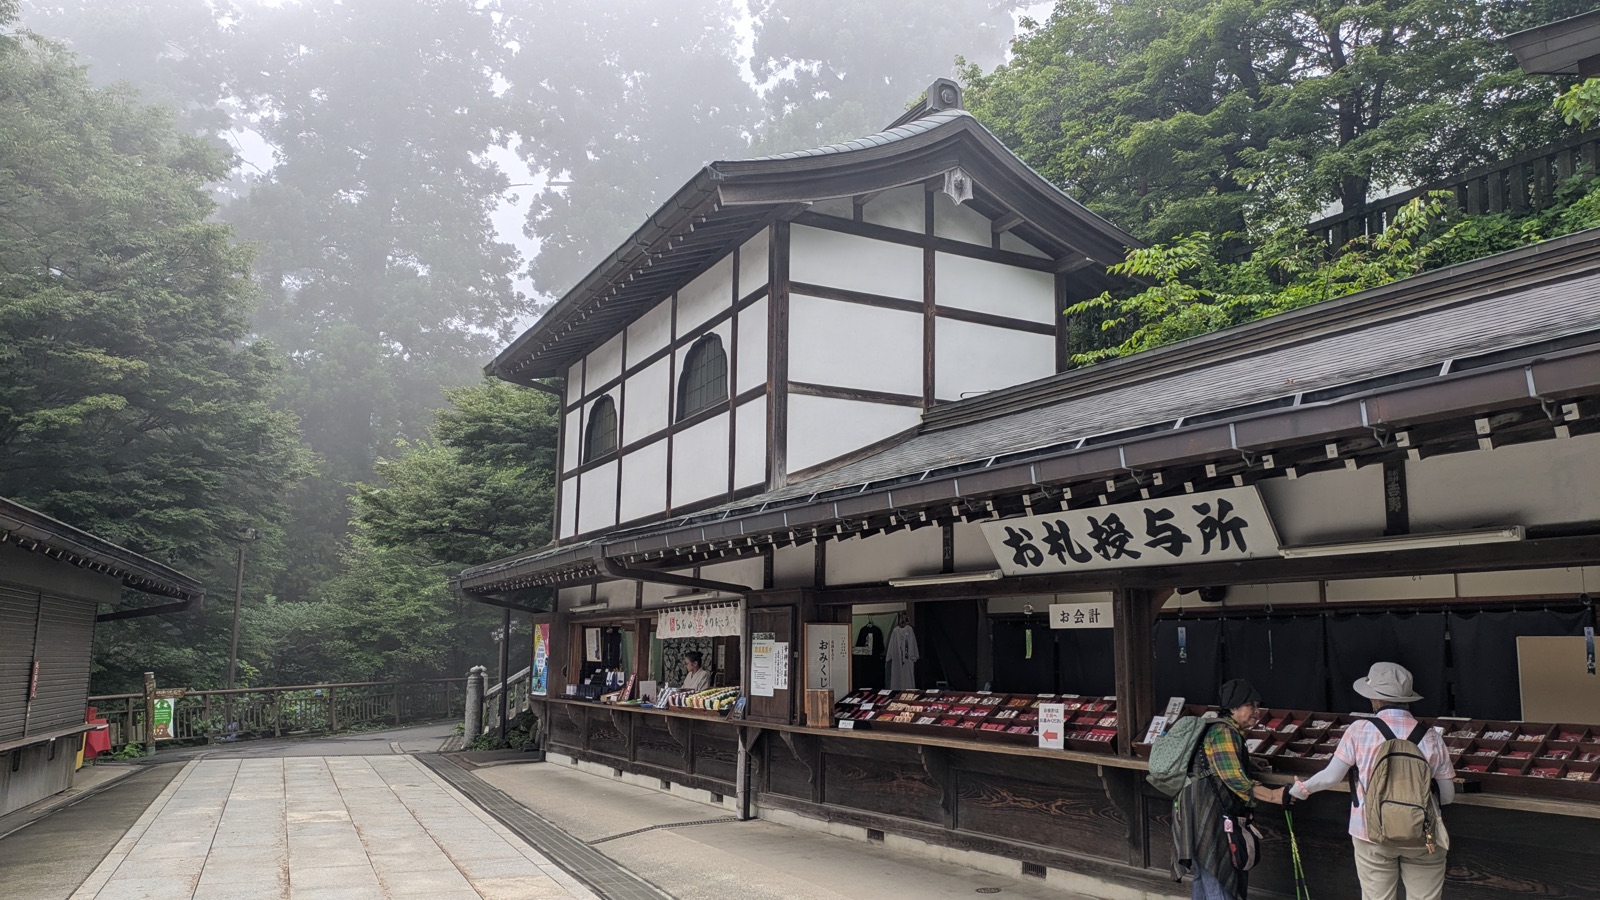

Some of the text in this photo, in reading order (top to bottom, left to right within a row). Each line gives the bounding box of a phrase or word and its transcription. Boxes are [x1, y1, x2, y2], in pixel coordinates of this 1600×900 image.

[1002, 497, 1249, 568] お札授与所
[1059, 607, 1101, 624] お会計
[818, 639, 829, 688] おみくじ
